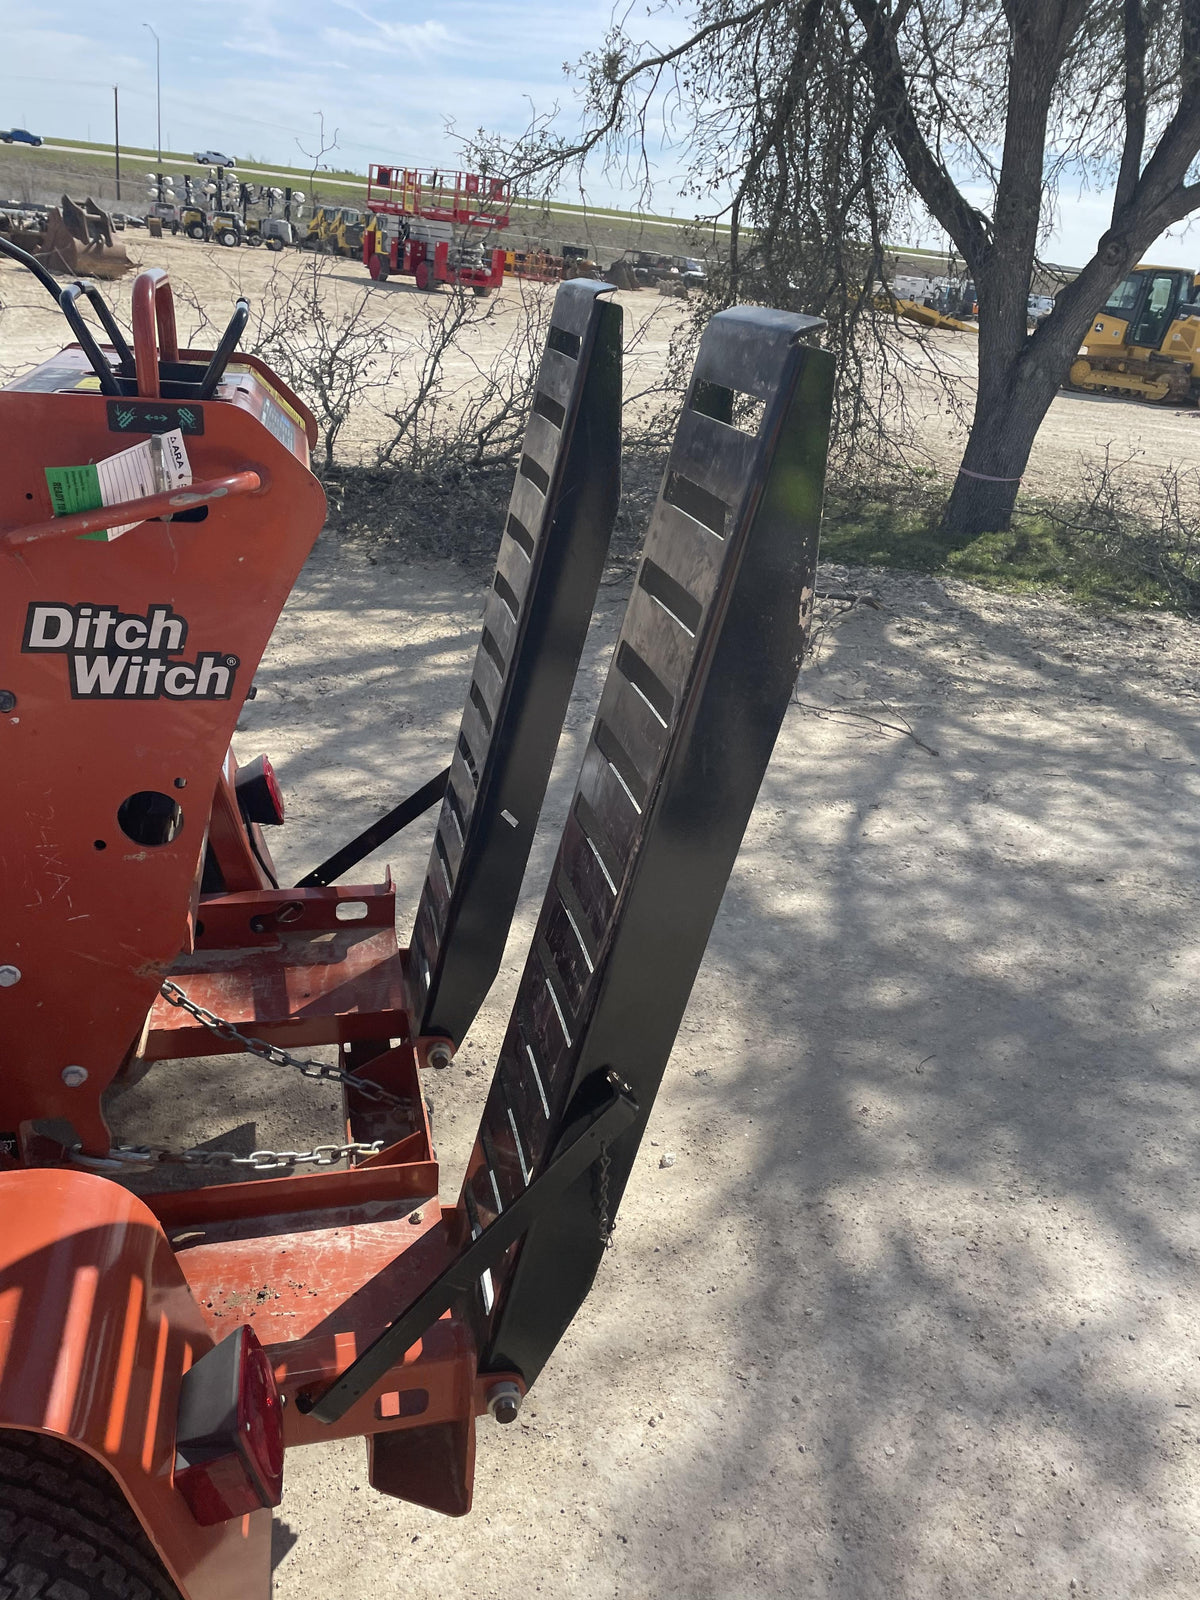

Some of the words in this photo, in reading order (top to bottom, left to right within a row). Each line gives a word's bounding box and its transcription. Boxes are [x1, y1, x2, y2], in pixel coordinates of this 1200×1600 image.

[172, 445, 184, 469] ARA
[53, 482, 65, 502] READY
[28, 607, 183, 649] Ditch
